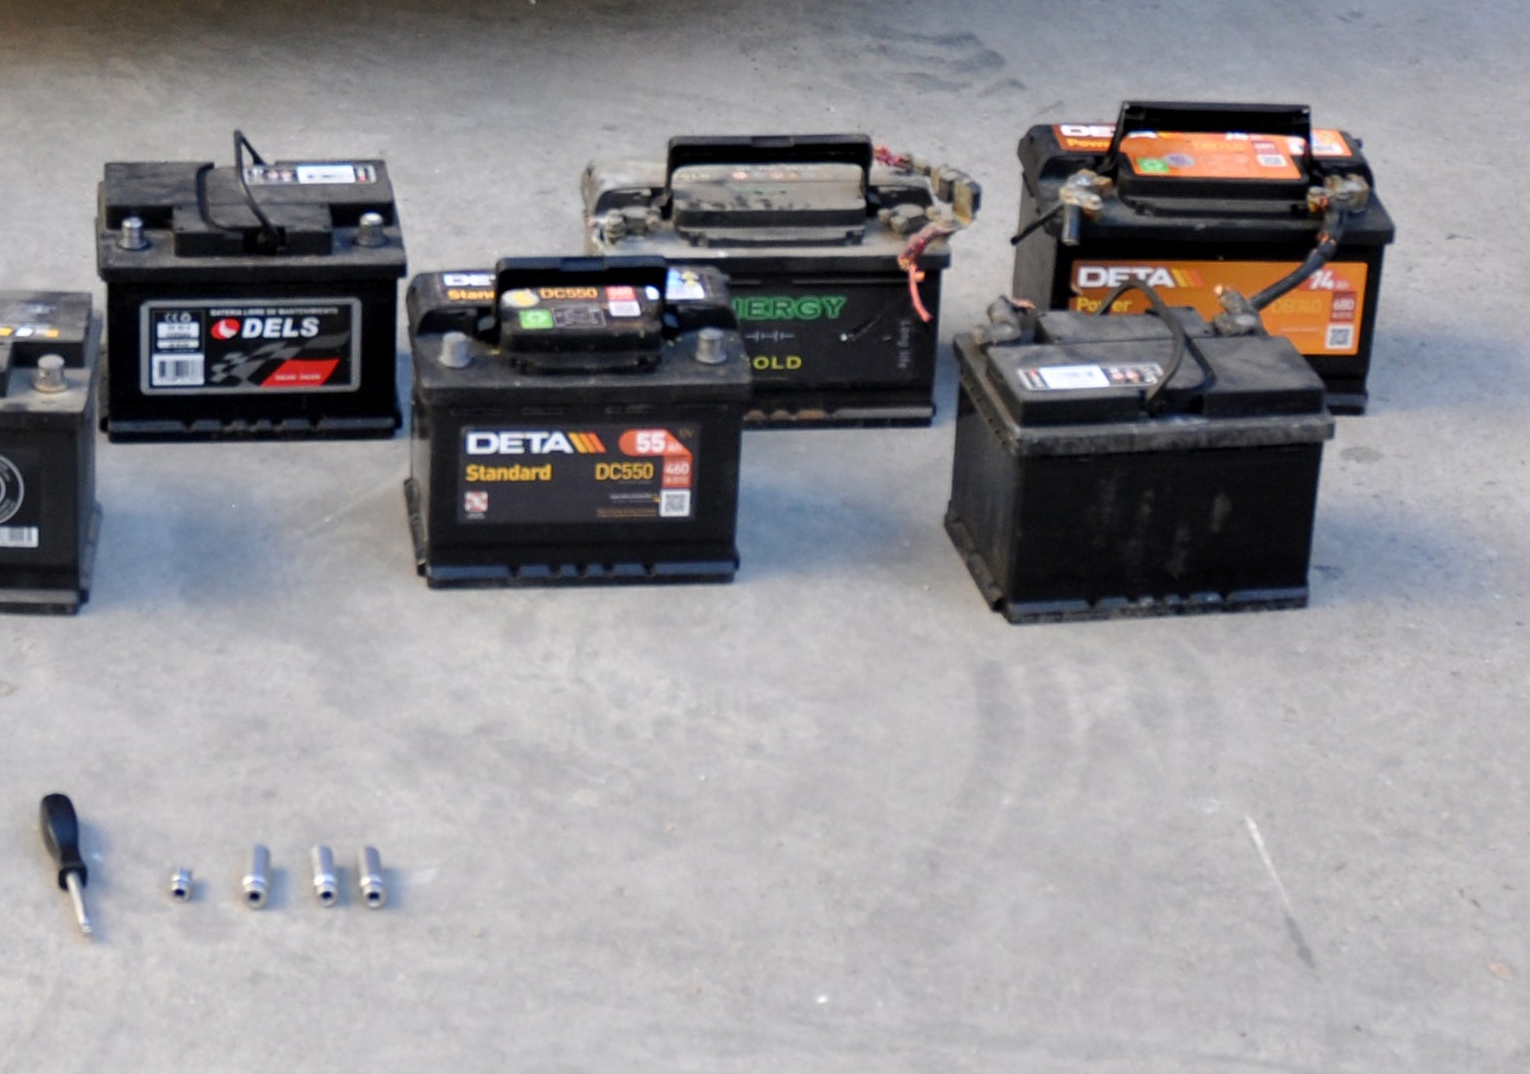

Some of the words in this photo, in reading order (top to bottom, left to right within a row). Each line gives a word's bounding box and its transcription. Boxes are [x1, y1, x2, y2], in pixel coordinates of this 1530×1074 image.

[1077, 266, 1175, 288] DETA
[539, 287, 599, 299] DC550
[731, 295, 847, 321] ERGY
[242, 317, 320, 339] DELS
[753, 355, 803, 370] OLD
[466, 430, 574, 455] DETA
[635, 431, 666, 453] 55
[465, 463, 552, 482] Standard
[595, 462, 654, 481] DC550
